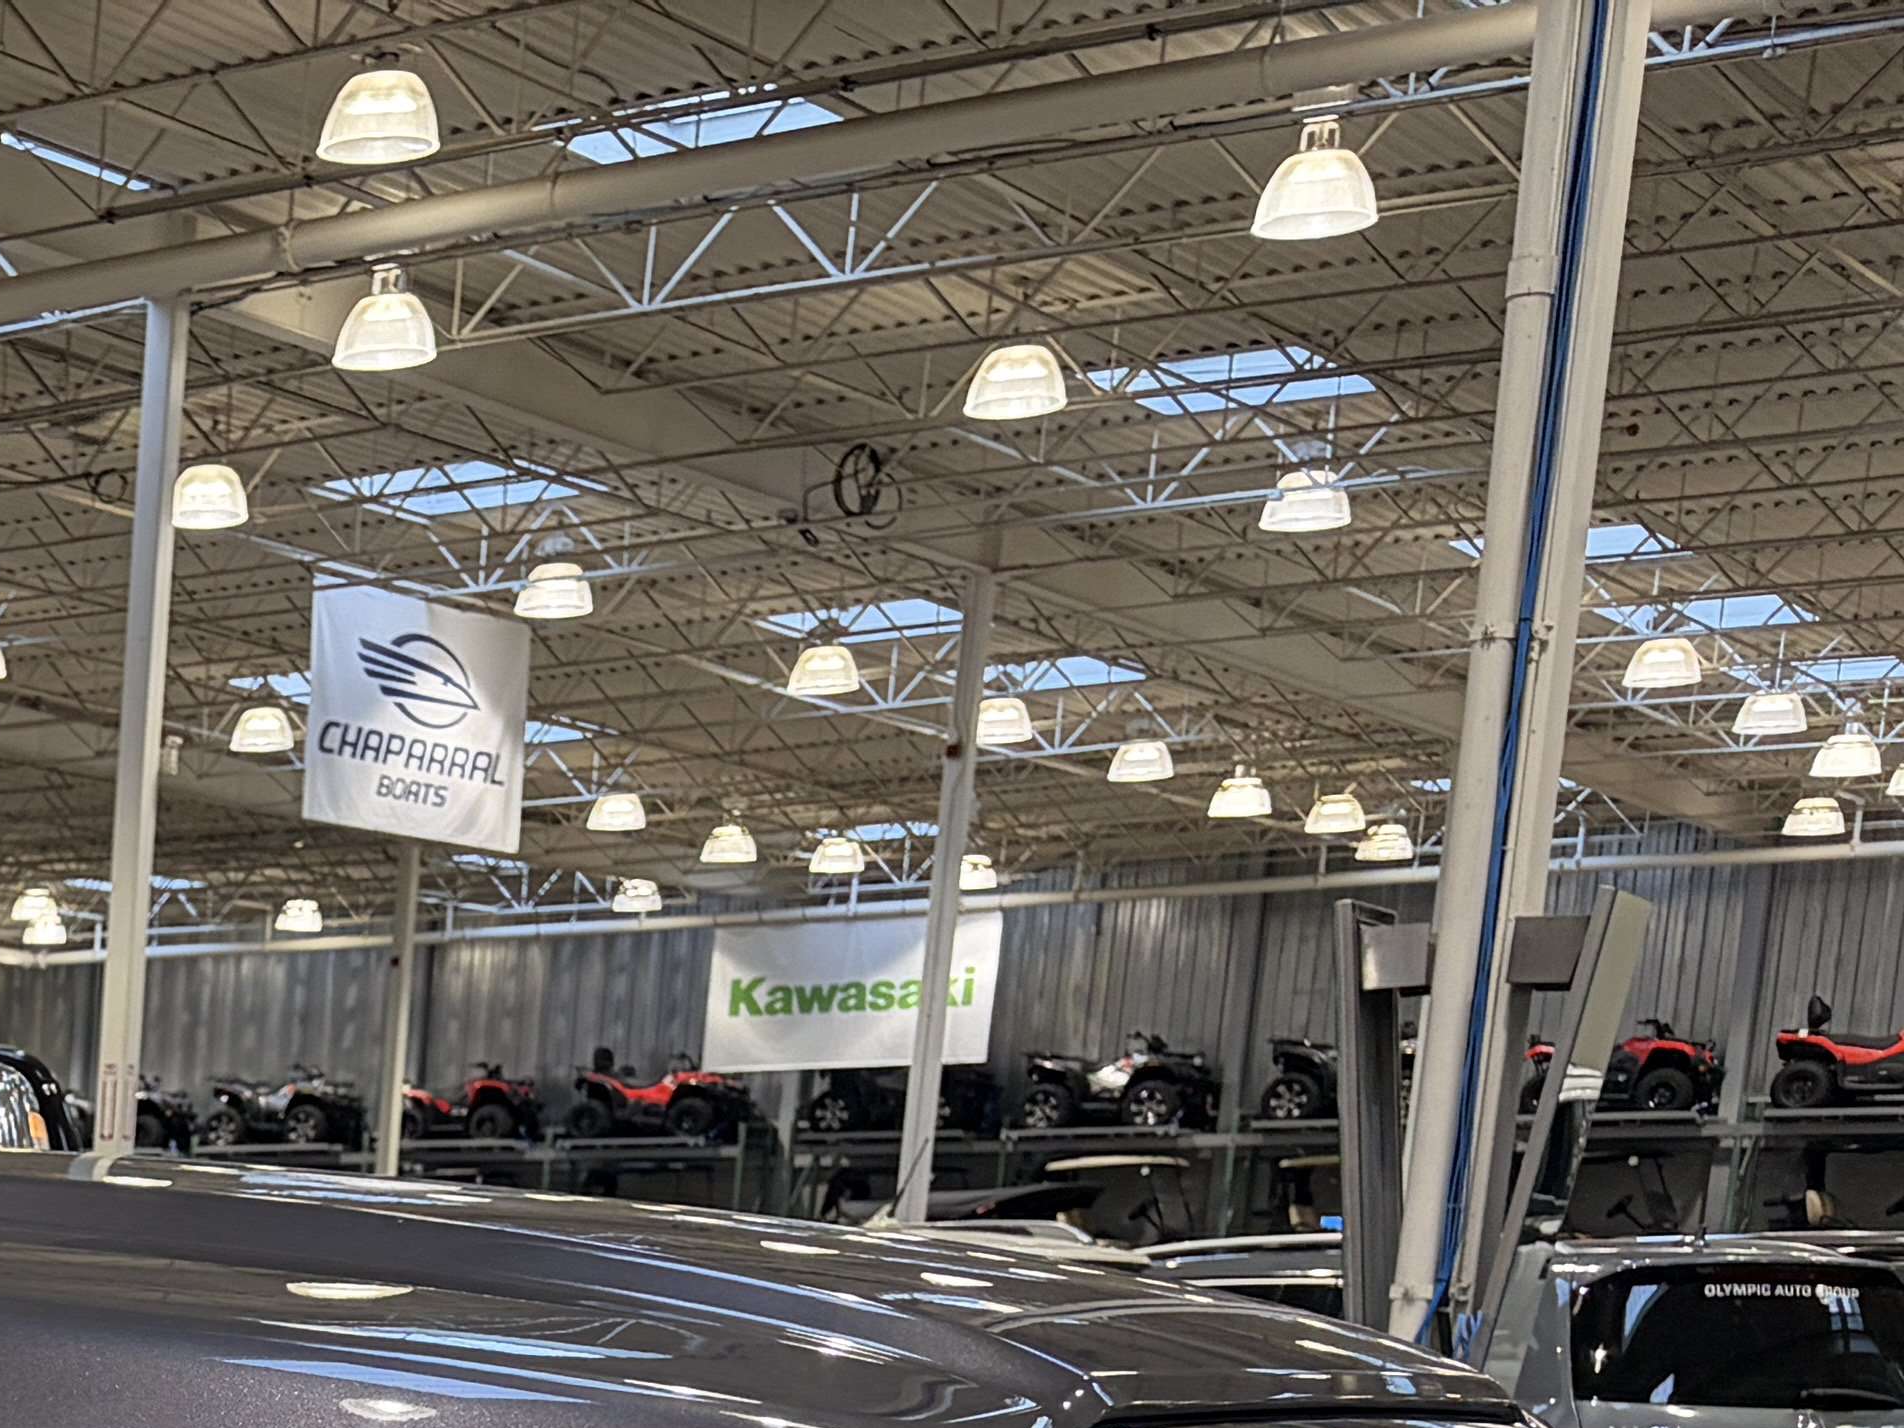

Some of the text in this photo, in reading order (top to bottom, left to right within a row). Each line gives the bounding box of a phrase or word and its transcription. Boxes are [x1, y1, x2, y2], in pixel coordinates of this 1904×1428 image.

[318, 720, 505, 786] CHAPARRAL
[376, 774, 449, 808] BOATS
[1704, 1283, 1771, 1297] OLYMPIC
[1774, 1284, 1812, 1297] AUTO
